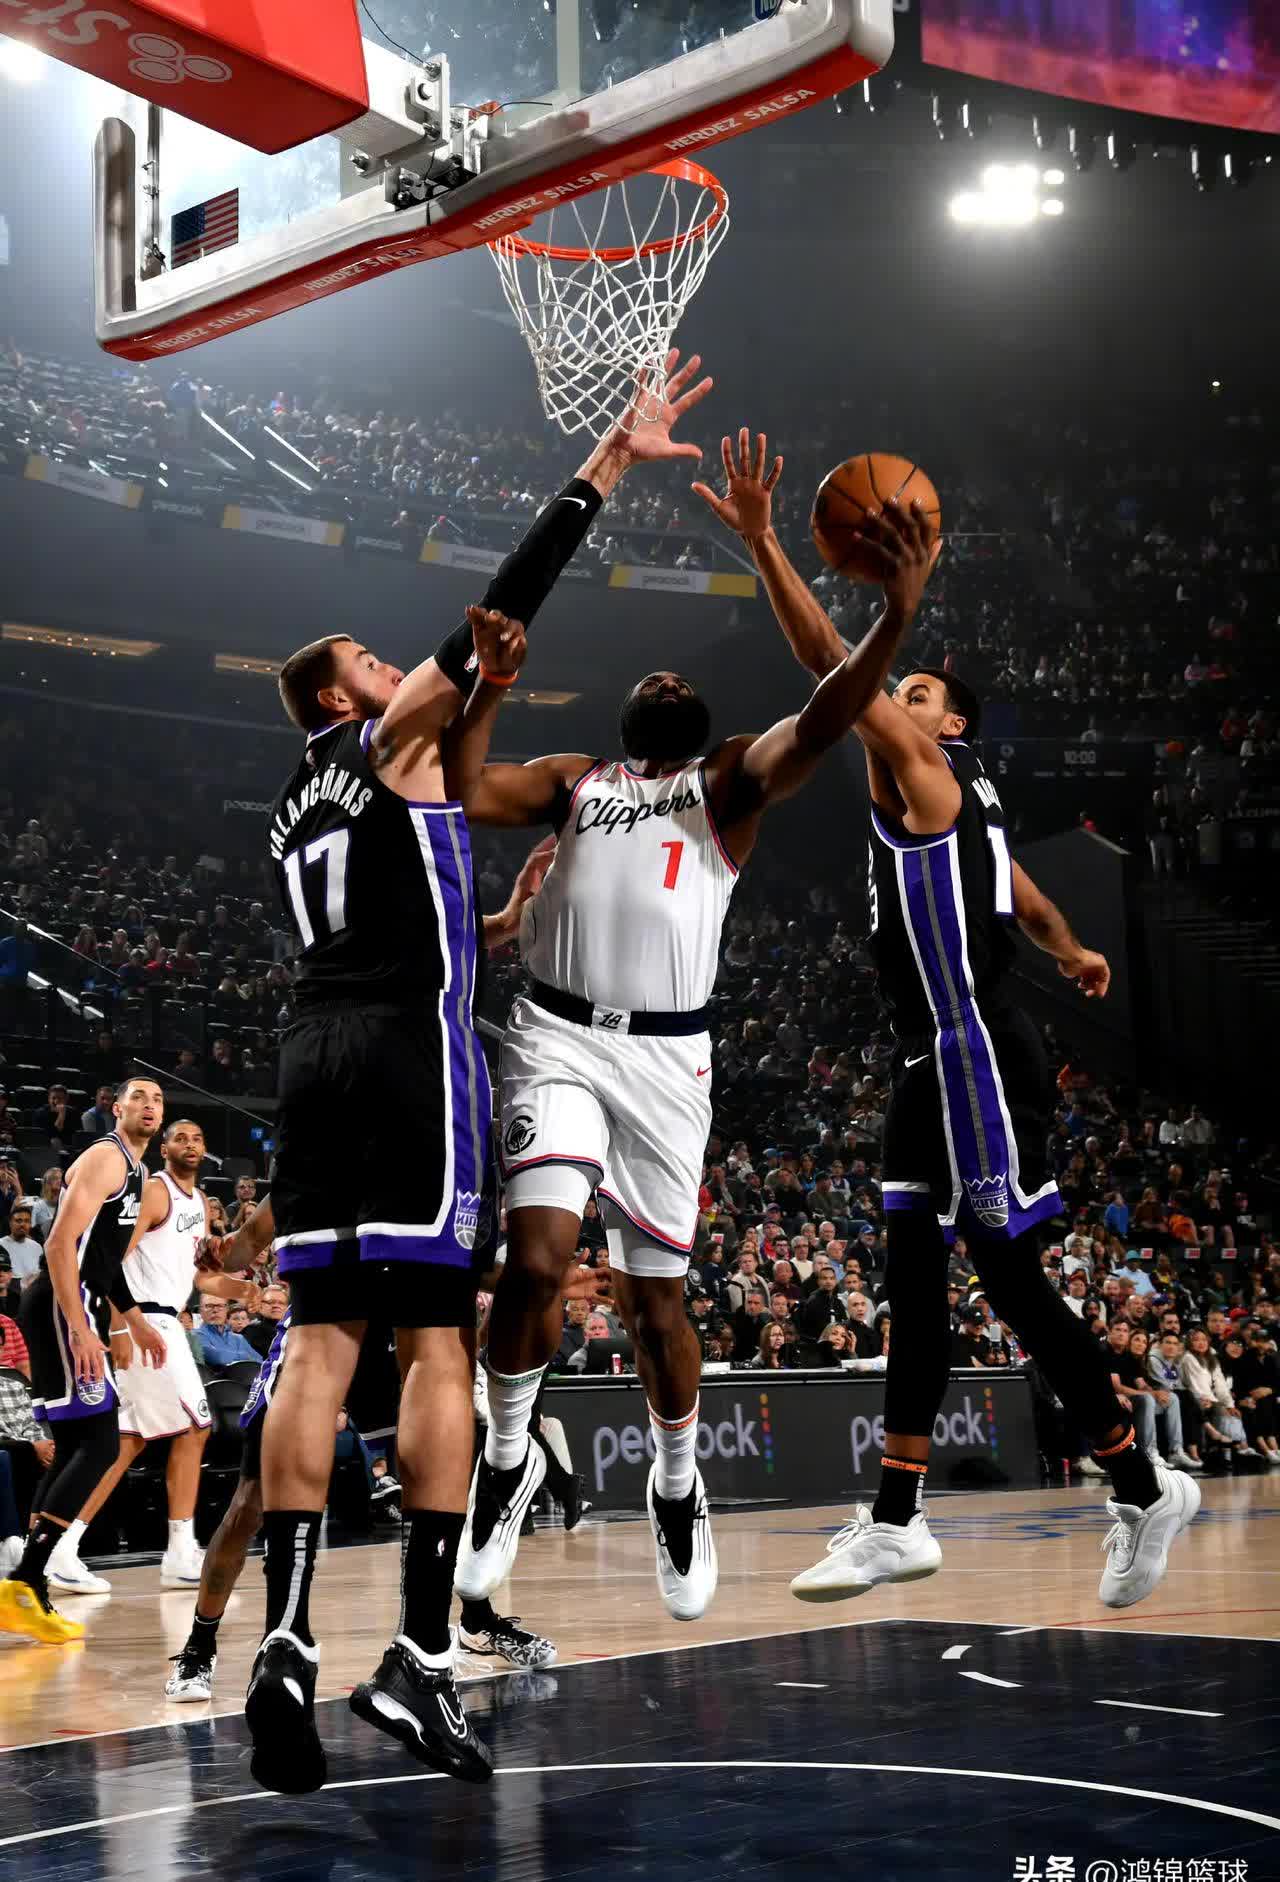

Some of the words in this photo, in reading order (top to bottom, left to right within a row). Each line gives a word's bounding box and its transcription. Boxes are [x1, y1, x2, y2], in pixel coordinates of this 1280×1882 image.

[664, 117, 742, 151] HERDEZ
[744, 88, 817, 120] SALSA
[472, 196, 543, 230] HERDEZ
[543, 171, 609, 199] SALSA
[303, 265, 366, 292] HERDEZ
[366, 248, 424, 268] SALSA
[152, 327, 209, 351] HERDEZ
[208, 306, 263, 329] SALSA
[223, 799, 272, 814] peacoc
[575, 788, 702, 835] Clippers
[281, 826, 350, 949] 17
[661, 841, 684, 890] 1
[986, 824, 1014, 914] 1
[592, 1402, 761, 1492] peock
[850, 1395, 988, 1475] peock
